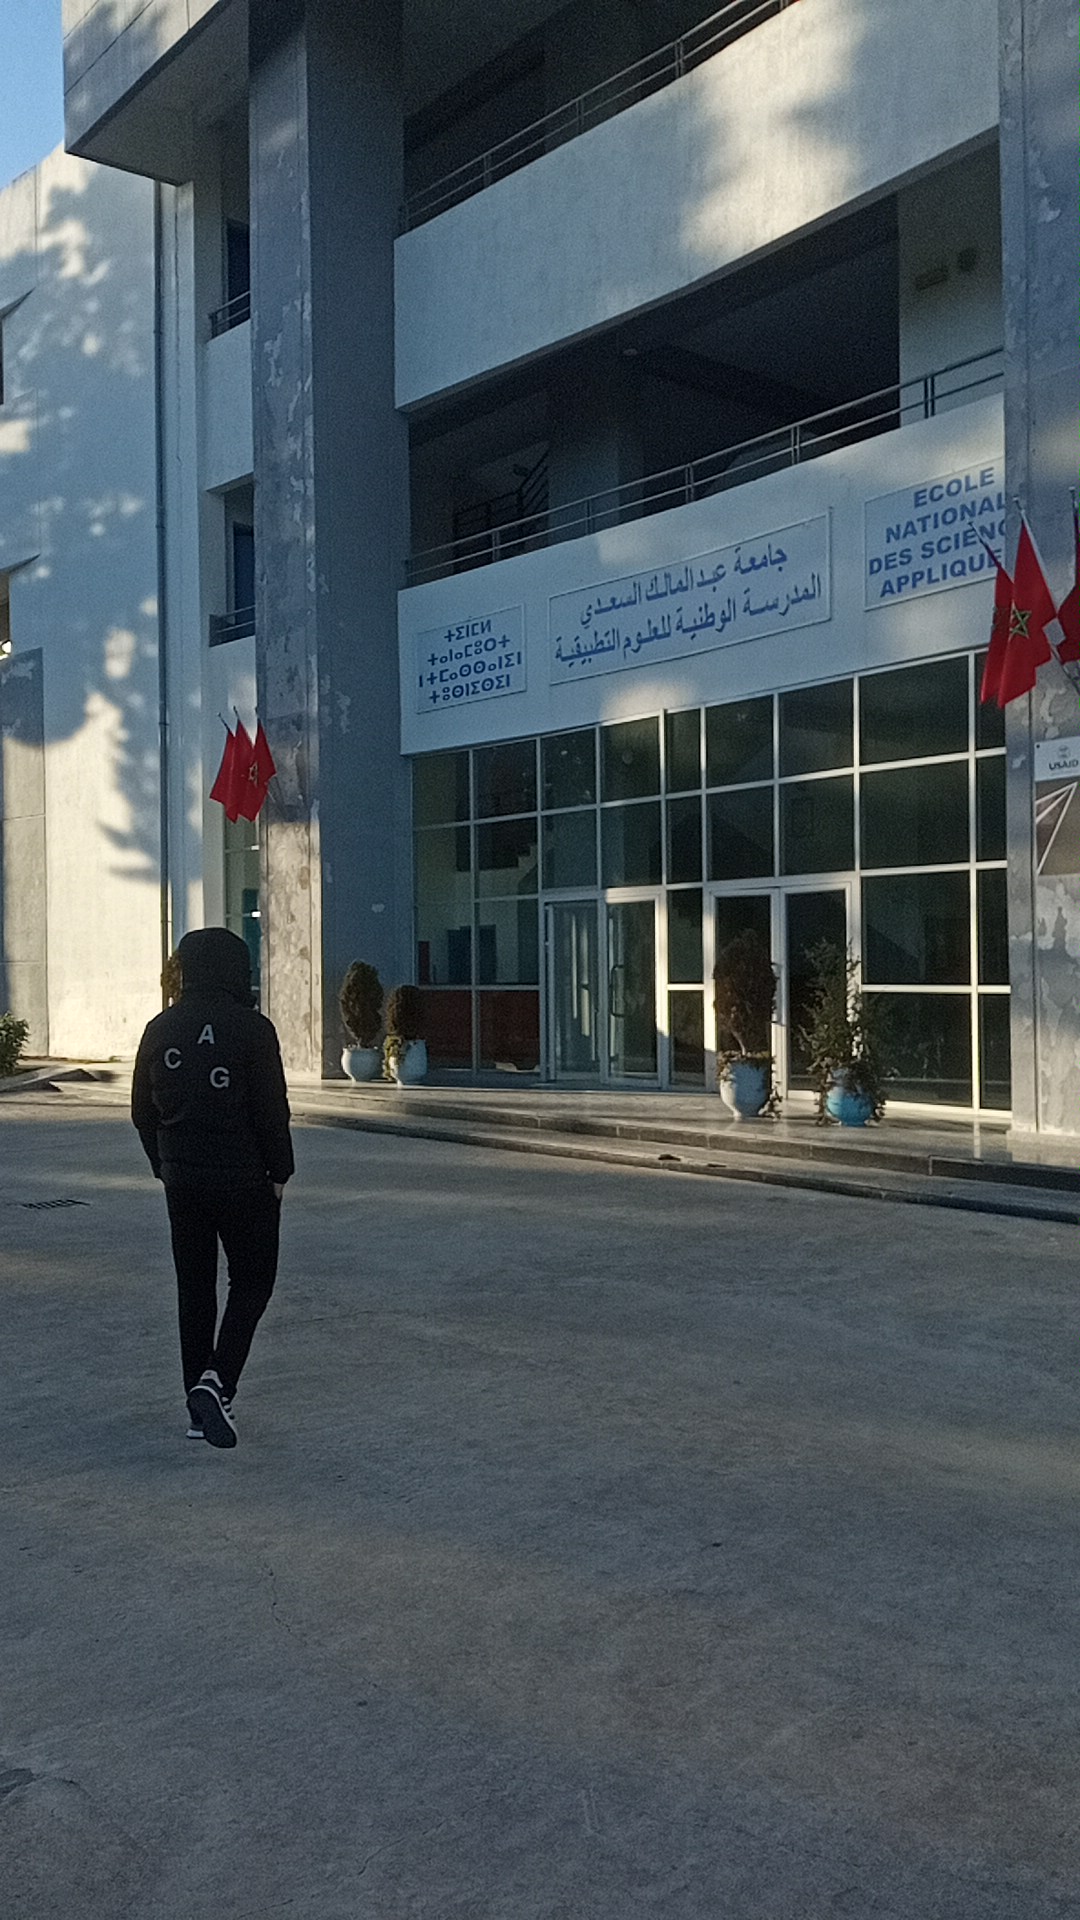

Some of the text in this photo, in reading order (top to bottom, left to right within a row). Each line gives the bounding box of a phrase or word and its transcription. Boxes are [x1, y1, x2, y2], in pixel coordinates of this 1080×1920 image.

[913, 467, 995, 509] ECOLE
[733, 542, 788, 575] جامعة
[869, 548, 913, 576] DES
[554, 571, 822, 668] المدرسة الوطنية للعلوم التطبيقية
[580, 581, 642, 630] السعدي
